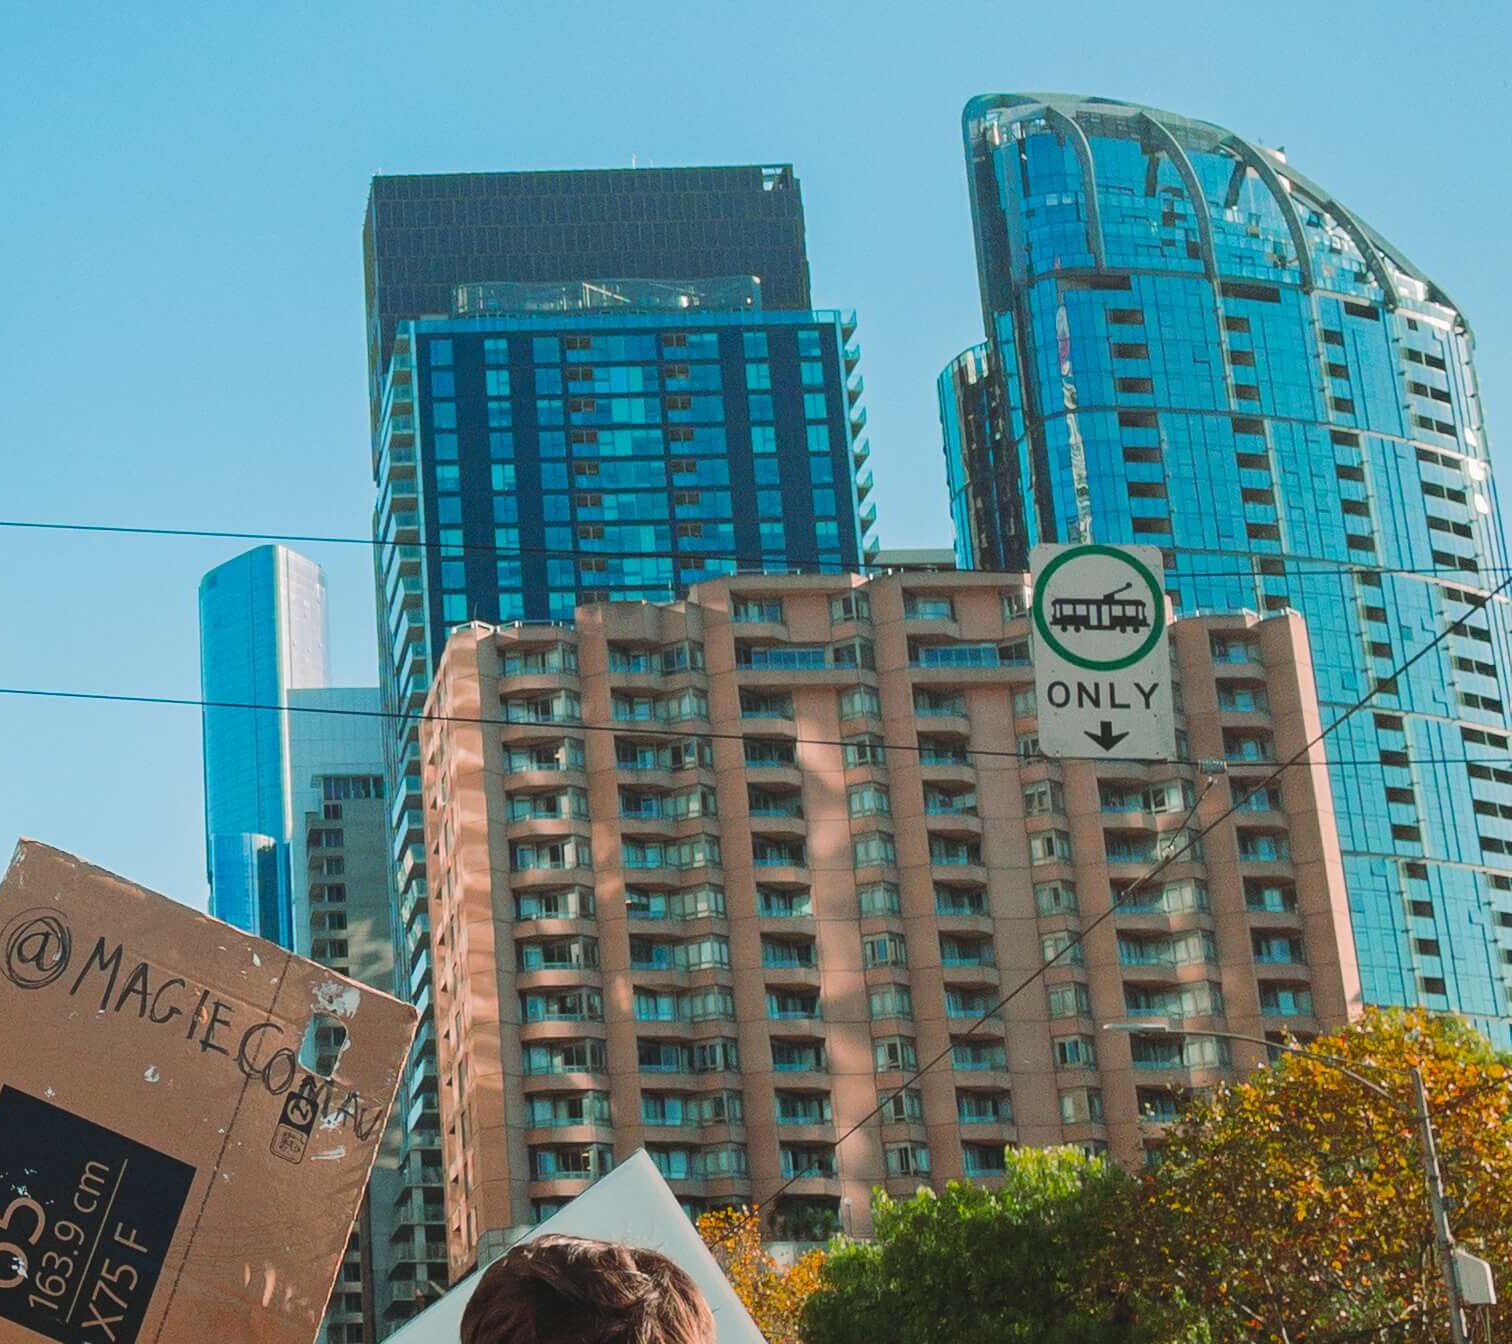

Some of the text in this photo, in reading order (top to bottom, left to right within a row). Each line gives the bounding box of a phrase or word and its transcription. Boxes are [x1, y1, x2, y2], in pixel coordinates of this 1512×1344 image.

[1047, 680, 1159, 710] ONLY
[28, 1160, 110, 1310] 163.9 cm
[81, 1222, 148, 1342] X75 F
